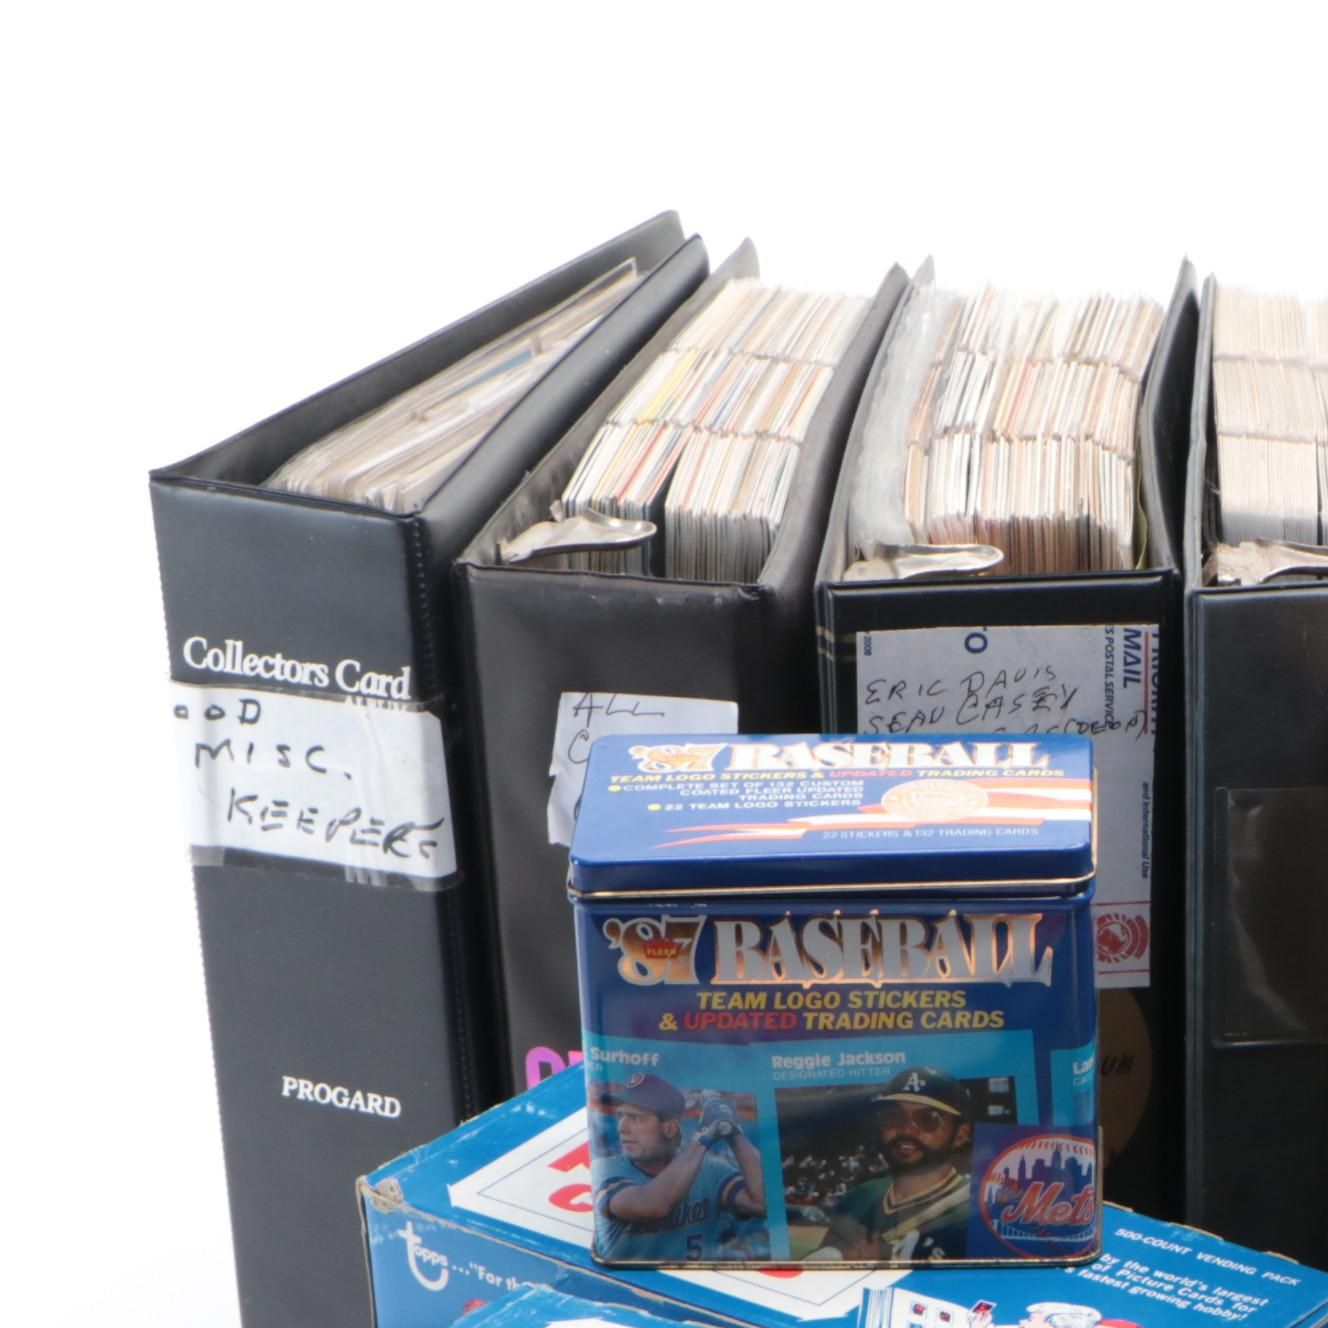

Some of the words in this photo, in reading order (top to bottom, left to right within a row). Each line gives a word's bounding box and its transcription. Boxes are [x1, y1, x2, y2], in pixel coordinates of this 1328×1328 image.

[183, 636, 329, 689] Collectors
[335, 659, 413, 701] Card
[1104, 644, 1114, 679] POSTAL
[1123, 628, 1141, 688] MAIL
[865, 679, 947, 705] ERIC
[573, 692, 665, 728] ALL
[194, 738, 352, 780] MISC.
[628, 742, 724, 773] '87
[724, 741, 1052, 771] BASEBALL
[610, 774, 661, 784] TEAM
[666, 773, 715, 782] LOGO
[720, 771, 808, 781] STICKERS
[829, 769, 913, 778] UPDATED
[917, 769, 994, 778] TRADING
[1002, 769, 1064, 777] CARDS
[623, 781, 701, 791] COMPLETE
[709, 781, 738, 790] SET
[745, 781, 764, 789] OF
[800, 779, 865, 788] CUSTOM
[680, 788, 740, 796] COATED
[747, 787, 793, 795] FLEER
[797, 786, 864, 794] UPDATED
[690, 802, 730, 810] TEAM
[735, 801, 779, 809] LOGO
[784, 799, 862, 808] STICKERS
[739, 793, 800, 801] TRADING
[804, 792, 864, 800] CARDS
[227, 787, 445, 859] KEEPERS
[840, 829, 899, 839] STICKERS
[940, 828, 992, 837] TRADING
[996, 828, 1039, 836] CARDS
[602, 914, 707, 986] '87
[711, 909, 1054, 988] BASEBALL
[696, 991, 767, 1010] TEAM
[773, 991, 841, 1010] LOGO
[848, 989, 967, 1009] STICKERS
[658, 1012, 679, 1031] &
[683, 1011, 799, 1031] UPDATED
[804, 1010, 914, 1030] TRADING
[921, 1009, 1005, 1029] CARDS
[590, 1046, 660, 1067] Surhoff
[772, 1055, 831, 1073] Reggie
[837, 1050, 907, 1067] Jackson
[772, 1069, 845, 1081] DESIGNATED
[848, 1067, 893, 1078] HITTER
[281, 1075, 401, 1120] PROGARD
[1001, 1181, 1095, 1226] Mets
[398, 1220, 450, 1292] topps
[1114, 1228, 1193, 1256] 500-COUNT
[1196, 1252, 1258, 1276] VENDING
[1261, 1271, 1302, 1287] PACK
[1078, 1268, 1130, 1290] fastest
[1129, 1285, 1192, 1310] growing
[1193, 1303, 1249, 1321] hobby!
[1091, 1262, 1111, 1272] of
[1116, 1267, 1175, 1292] Picture
[1177, 1287, 1225, 1306] Cards
[1231, 1301, 1258, 1314] for
[1099, 1253, 1121, 1265] by
[1123, 1260, 1150, 1274] the
[1153, 1269, 1209, 1292] world's
[1212, 1287, 1269, 1306] largest
